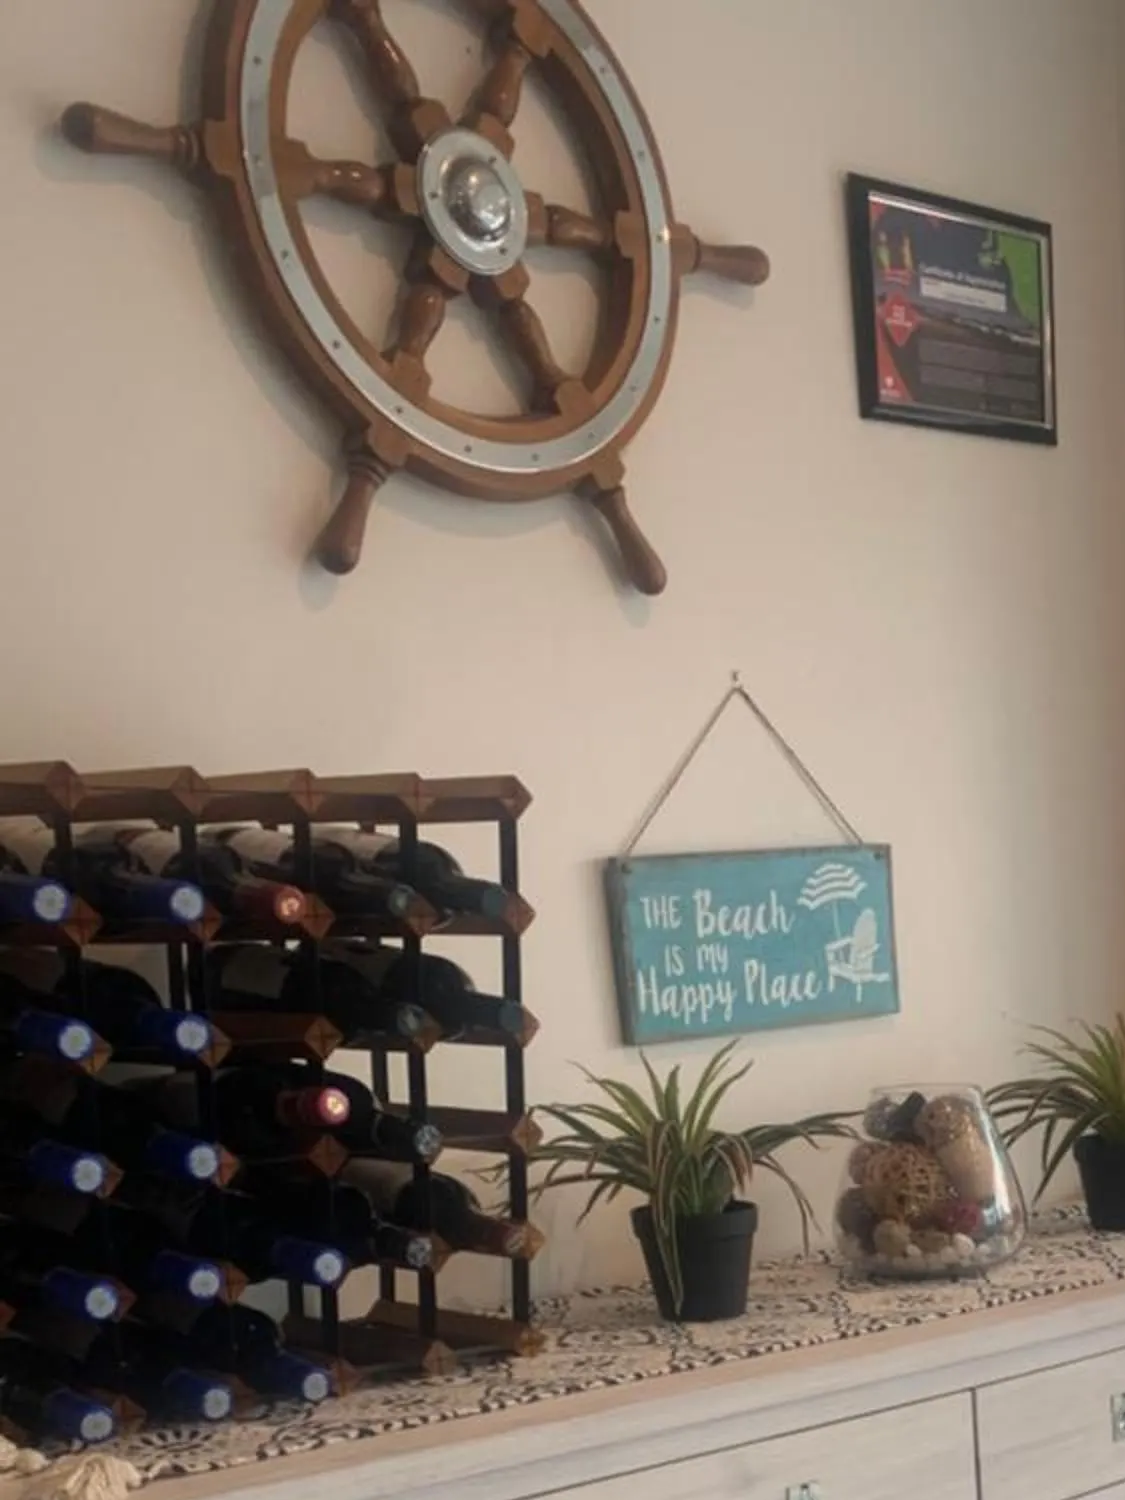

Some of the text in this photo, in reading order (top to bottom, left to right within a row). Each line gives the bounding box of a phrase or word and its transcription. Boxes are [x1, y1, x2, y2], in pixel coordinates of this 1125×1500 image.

[640, 888, 795, 938] THE Beach
[664, 944, 684, 977] IS
[636, 959, 822, 1025] Happy Place
